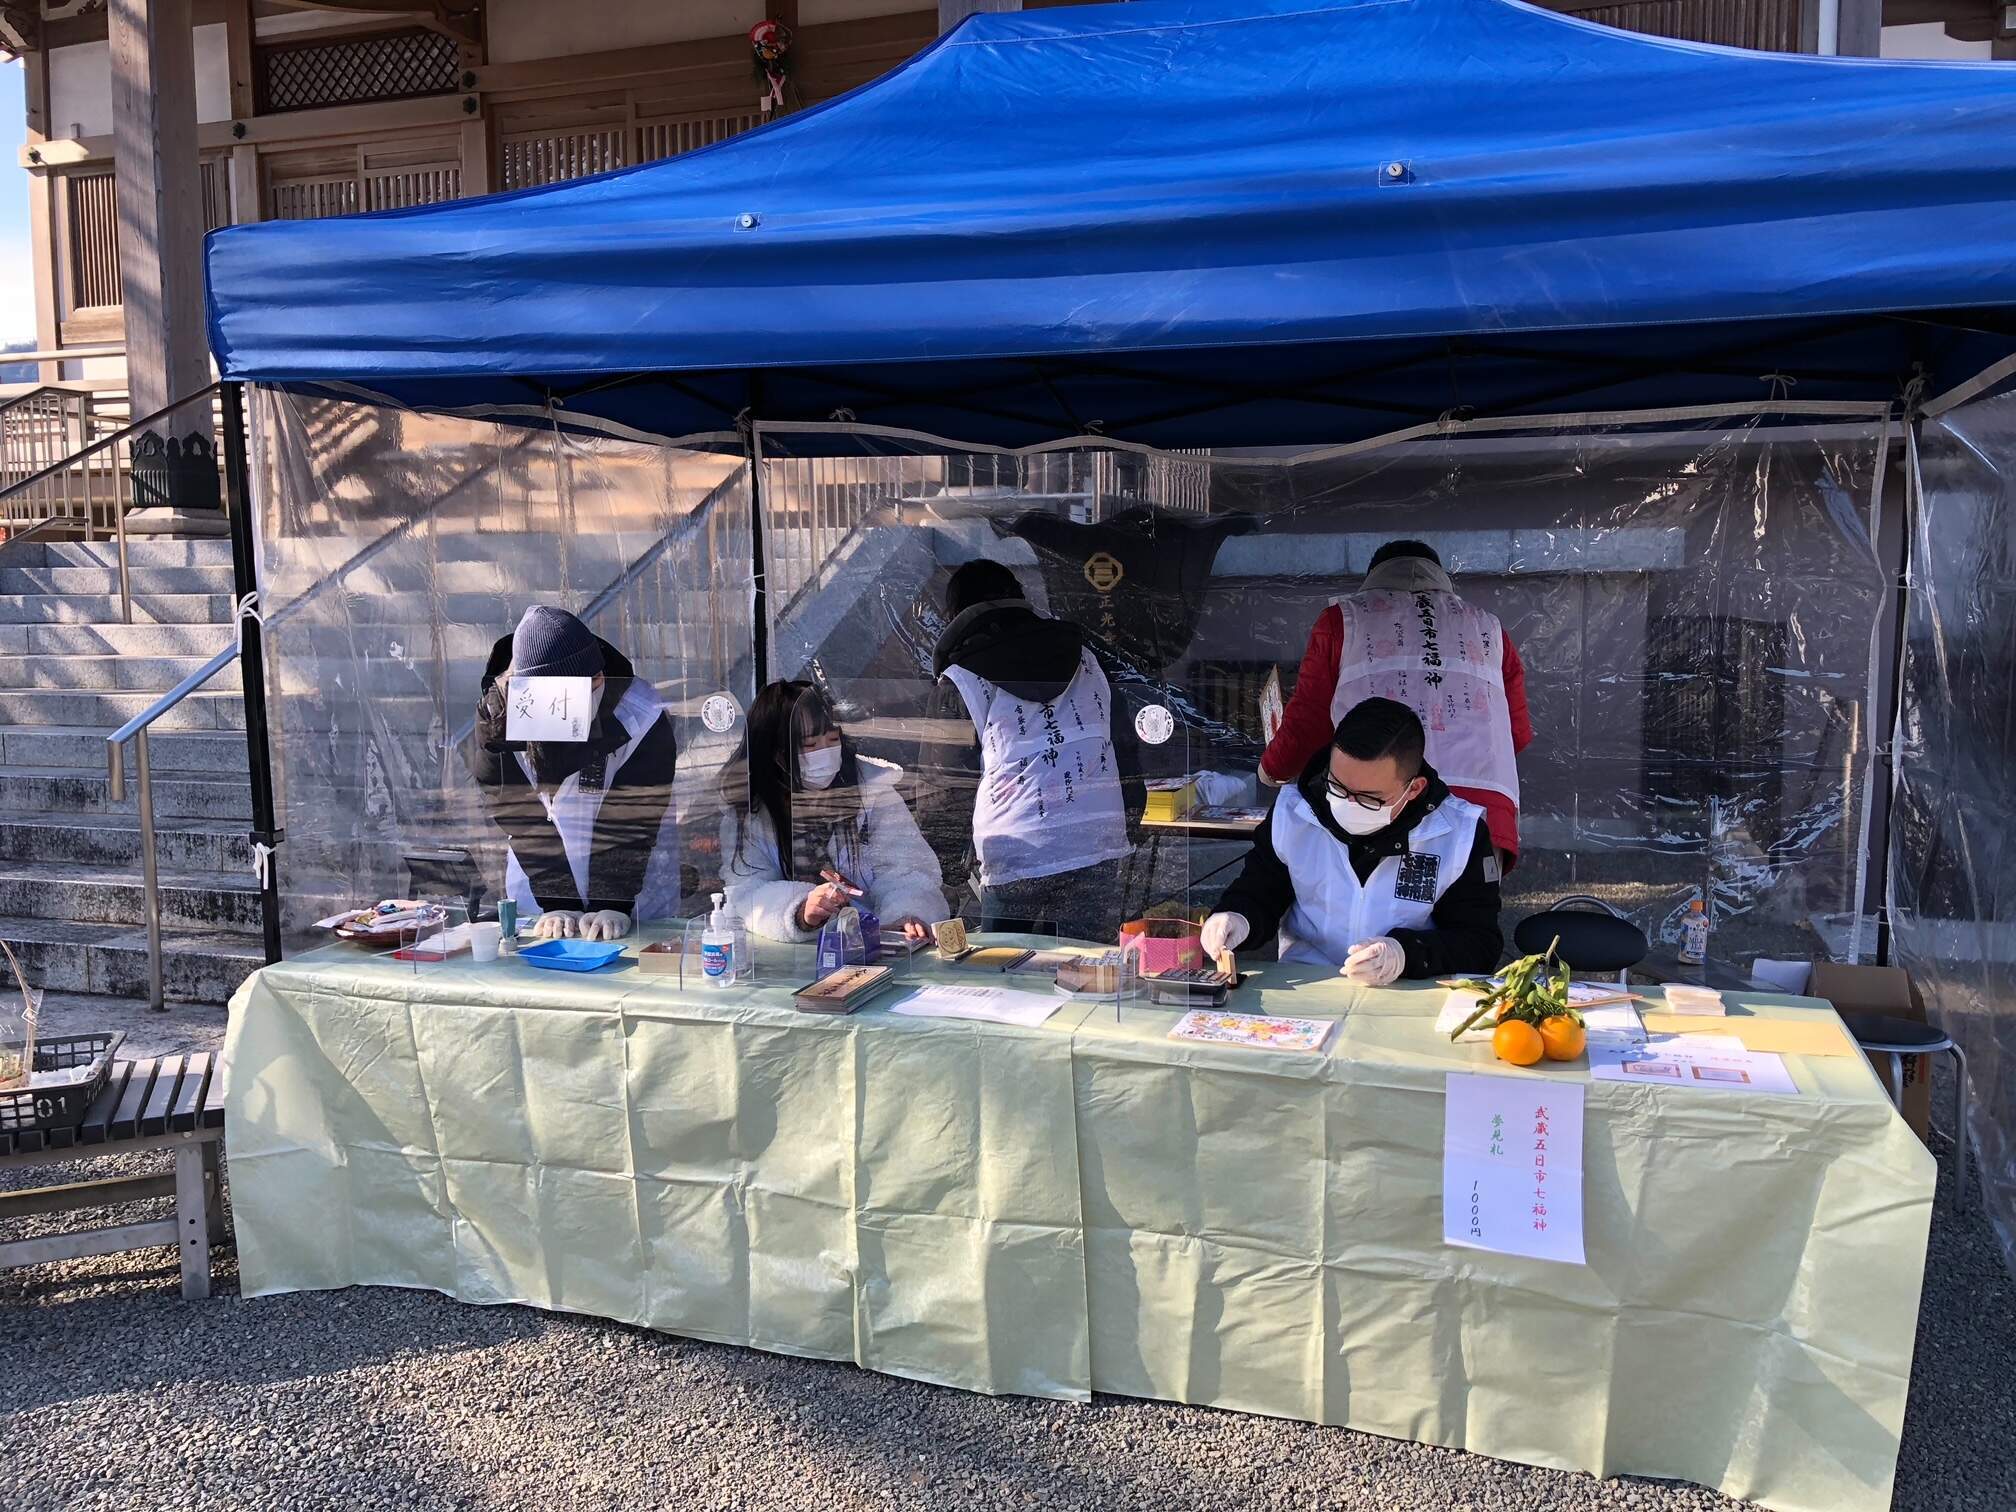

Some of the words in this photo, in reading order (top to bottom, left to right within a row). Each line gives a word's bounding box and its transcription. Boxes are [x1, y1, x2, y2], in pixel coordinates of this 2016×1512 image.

[1409, 591, 1442, 690] 蔵五日市七福神
[515, 688, 576, 721] 受付
[36, 1096, 68, 1119] 01
[1531, 1106, 1549, 1232] 武蔵五日市七福神
